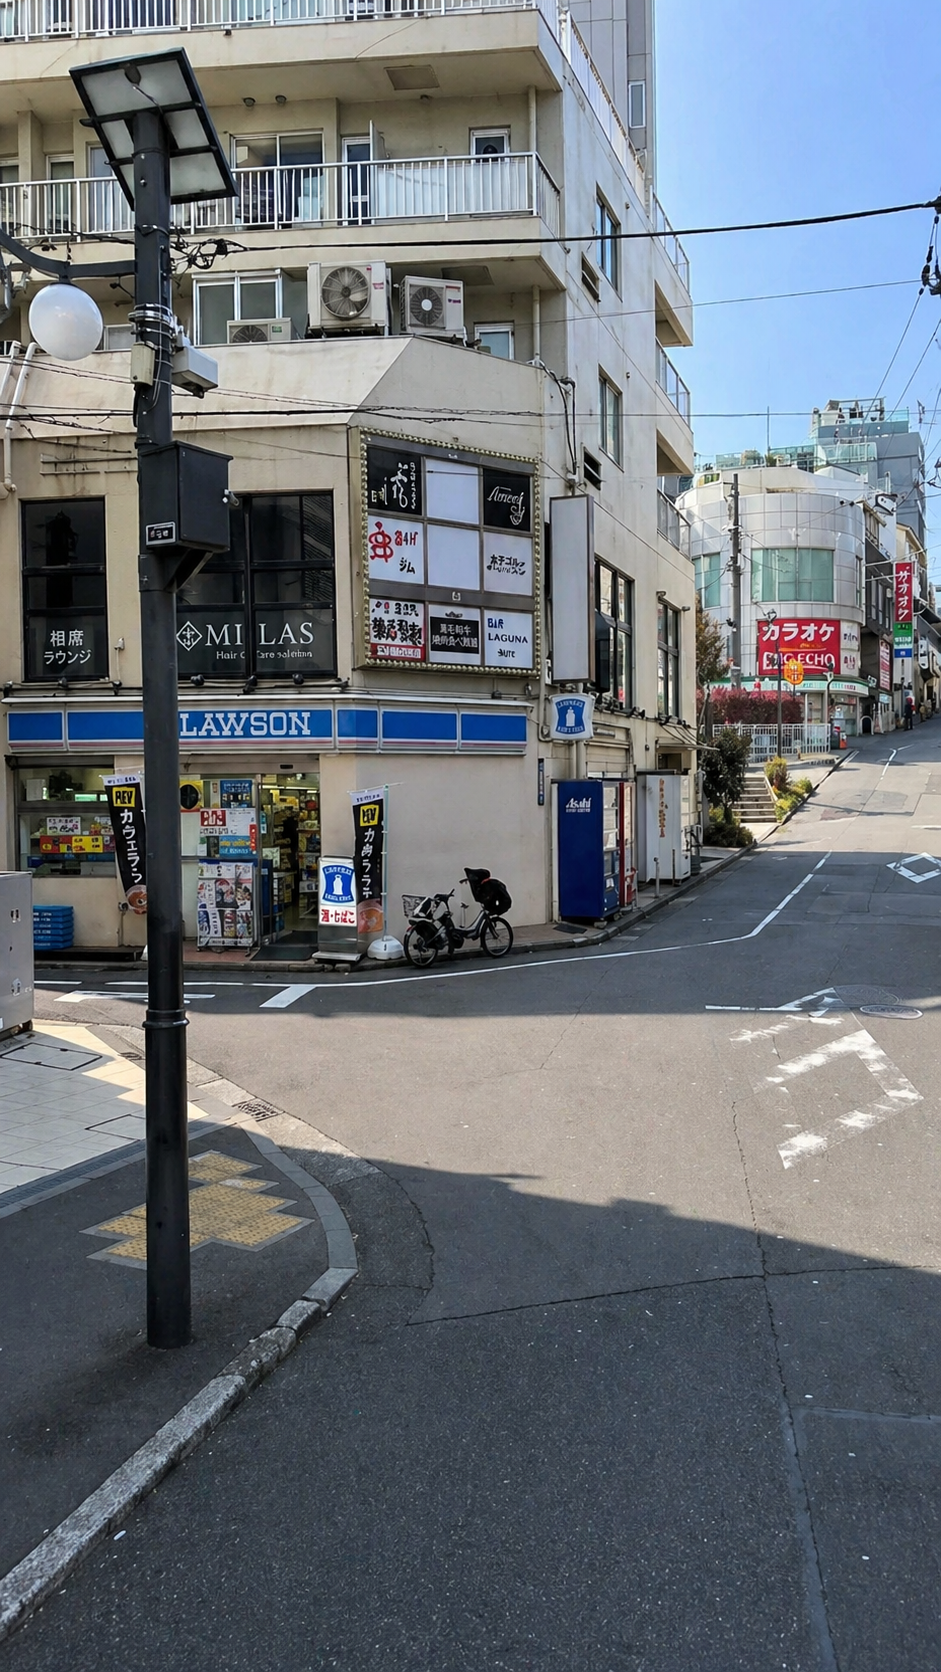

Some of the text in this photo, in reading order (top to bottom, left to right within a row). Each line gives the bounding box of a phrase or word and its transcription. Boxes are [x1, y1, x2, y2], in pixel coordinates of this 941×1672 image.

[50, 629, 84, 647] 相席
[488, 632, 529, 644] LAGUNA
[762, 622, 835, 642] カラオケ
[43, 649, 92, 665] ラウンジ
[216, 650, 237, 660] Hair
[797, 652, 835, 668] ECHO
[180, 712, 311, 736] LAWSON
